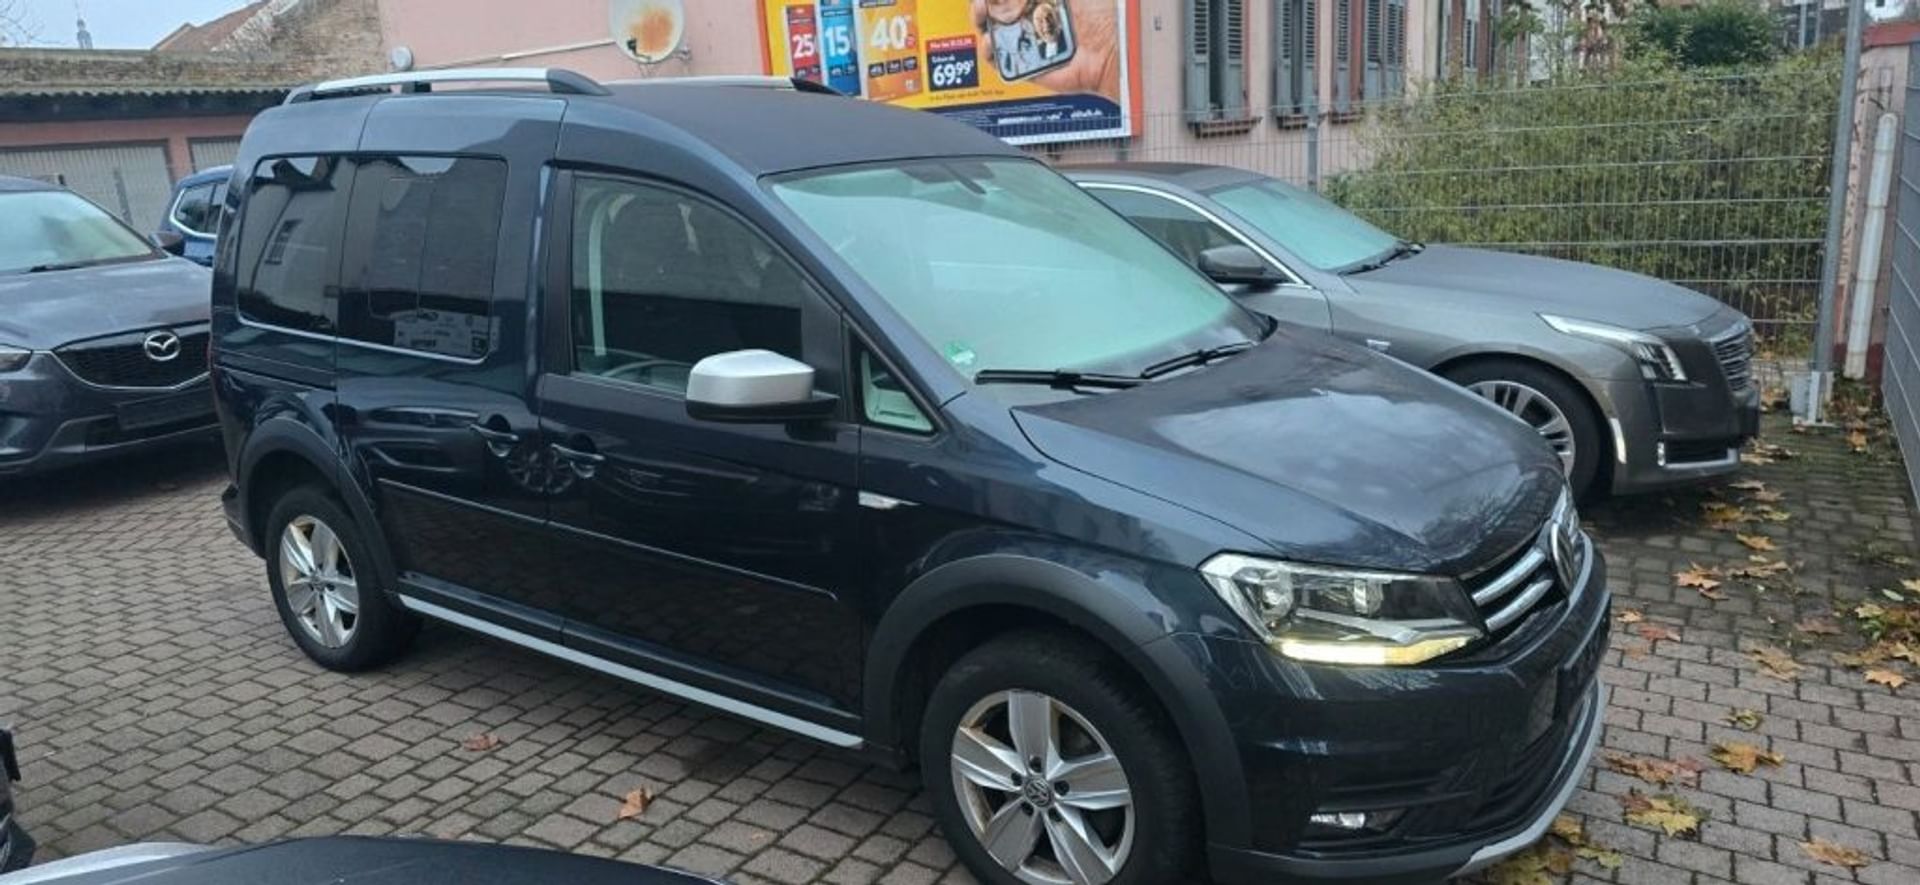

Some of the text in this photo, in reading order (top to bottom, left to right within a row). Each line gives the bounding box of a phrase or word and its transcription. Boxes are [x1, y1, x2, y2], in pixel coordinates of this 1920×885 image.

[792, 34, 815, 59] 25
[825, 25, 850, 57] 15
[871, 15, 908, 51] 40
